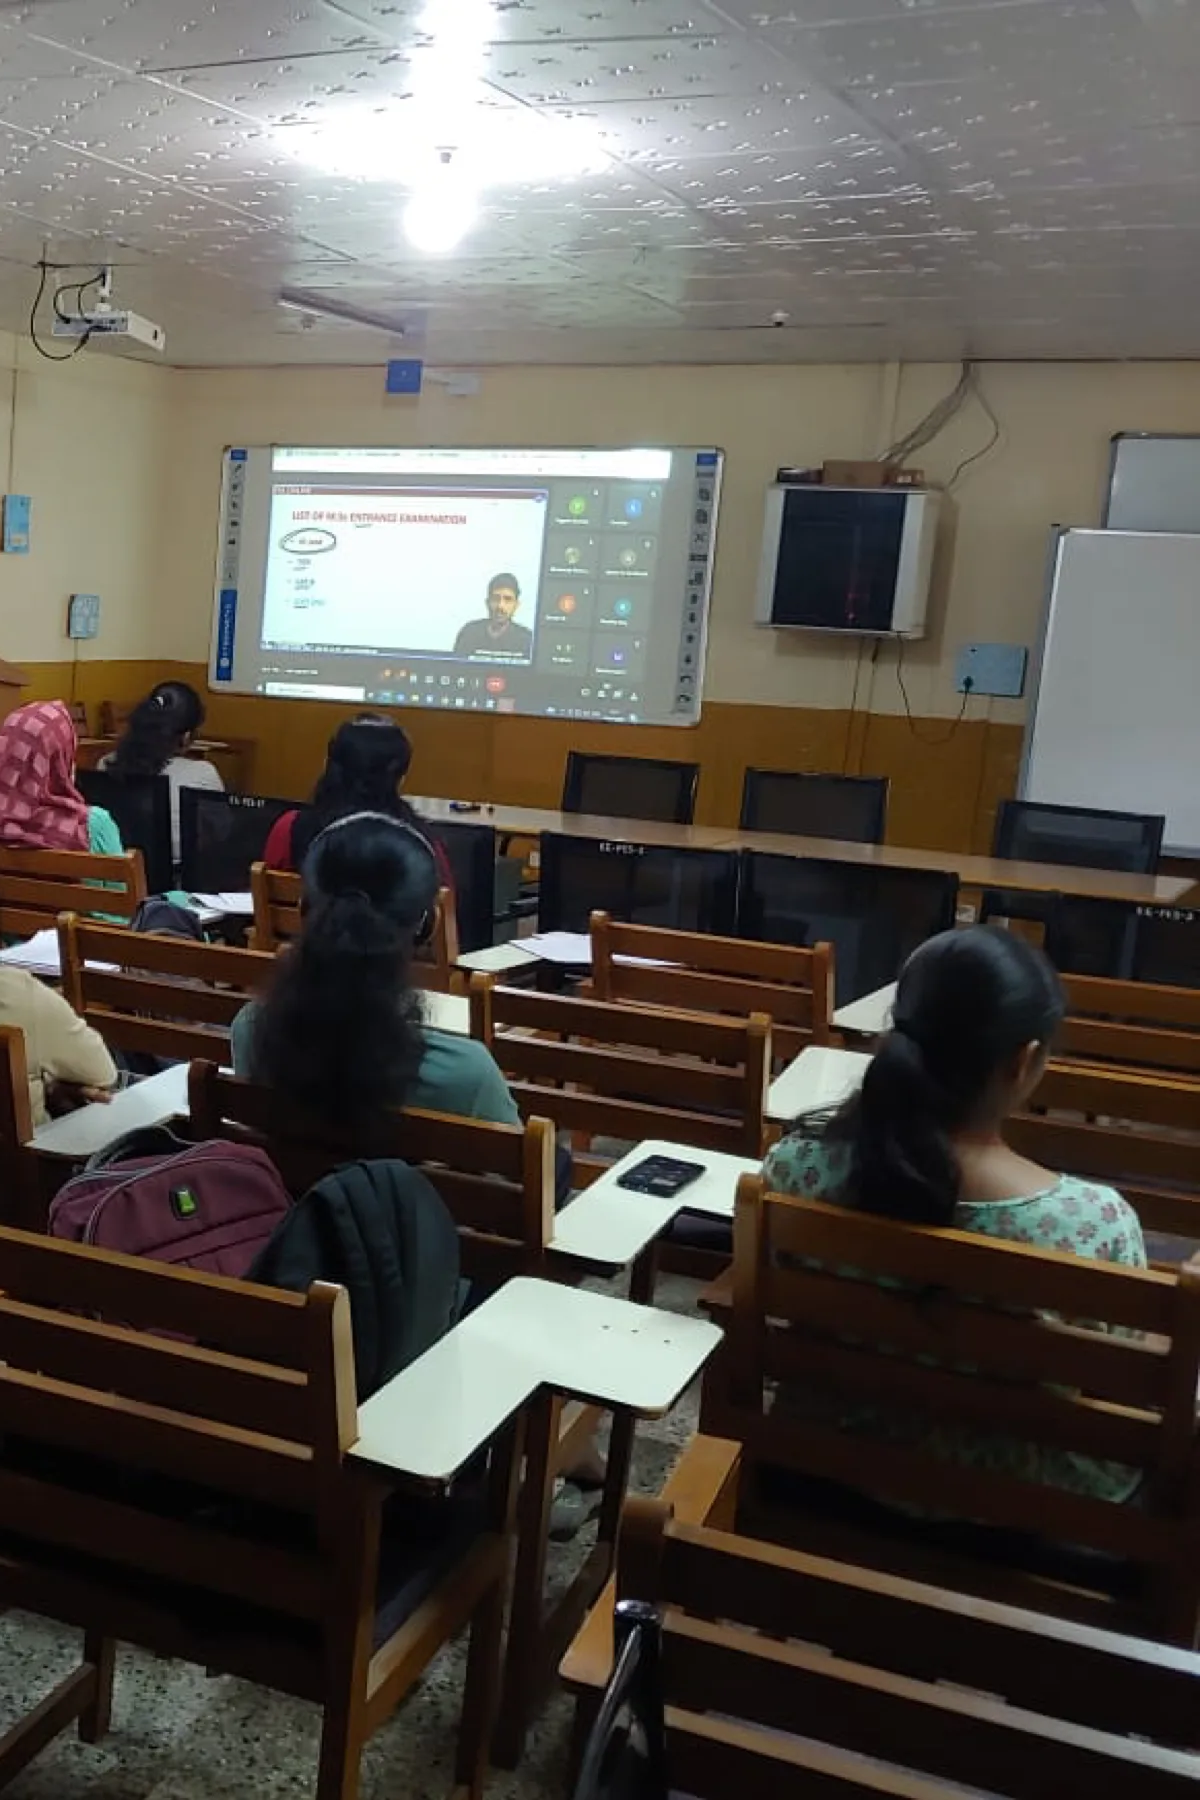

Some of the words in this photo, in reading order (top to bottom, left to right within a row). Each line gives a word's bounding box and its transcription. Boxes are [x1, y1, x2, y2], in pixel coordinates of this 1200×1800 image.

[292, 510, 310, 520] LIST
[312, 510, 324, 521] OF
[350, 512, 397, 523] ENTRANCE
[399, 513, 467, 524] EXAMINATION
